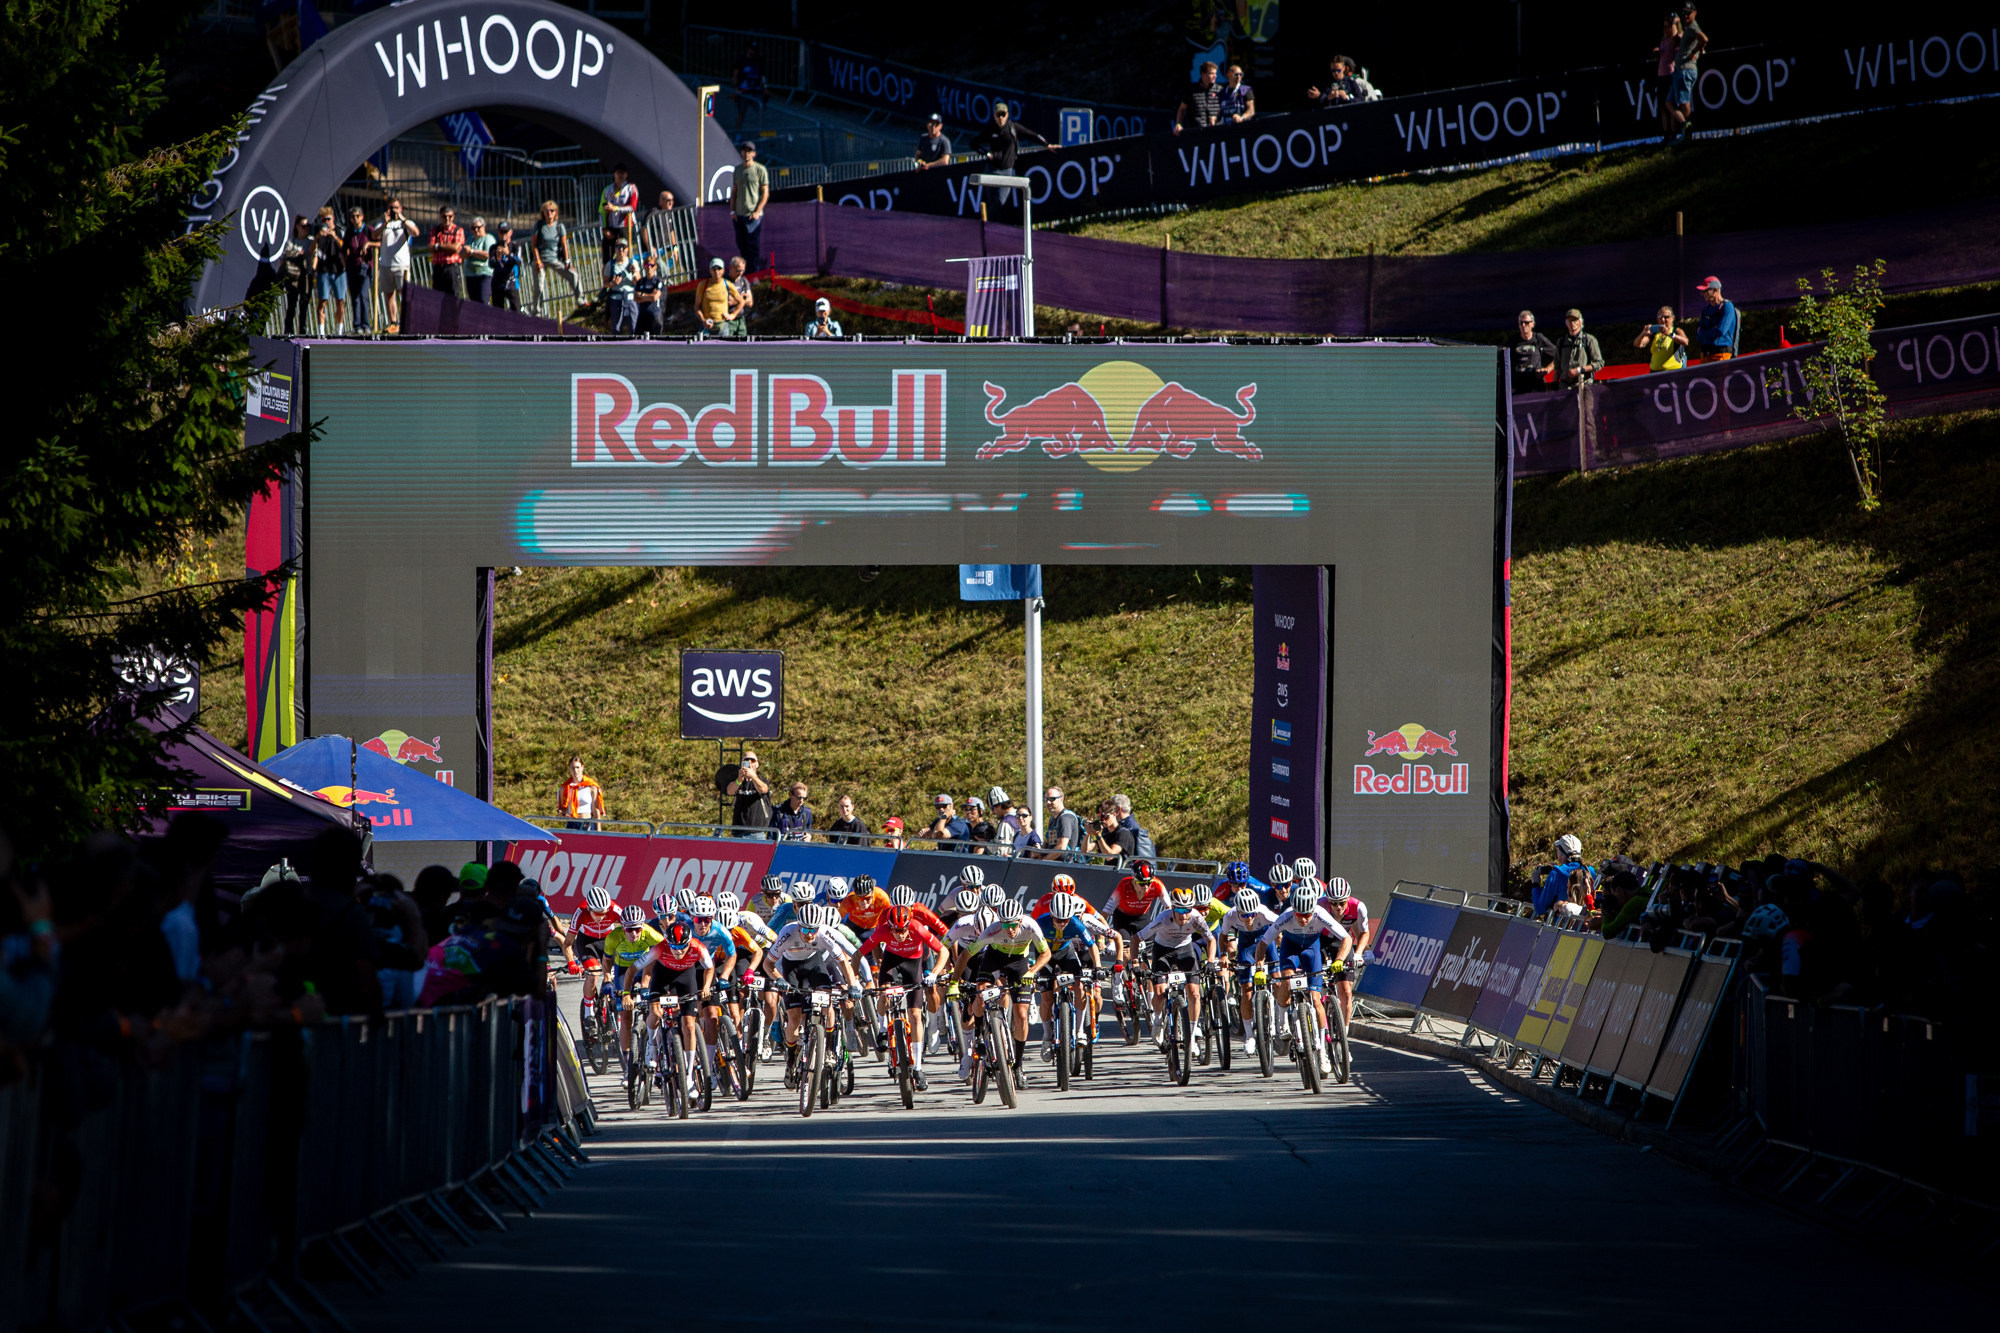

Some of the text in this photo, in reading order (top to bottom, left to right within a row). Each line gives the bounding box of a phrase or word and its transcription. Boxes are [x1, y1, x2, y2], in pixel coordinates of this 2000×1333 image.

[374, 14, 604, 97] WHOOP
[1844, 27, 2000, 91] WHOO
[828, 56, 914, 105] WHOOP
[1624, 58, 1790, 121] WOOP
[1067, 115, 1081, 142] P
[1394, 91, 1561, 152] WHOOP
[1178, 123, 1343, 187] WHOOP
[946, 156, 1116, 216] WOOP
[571, 369, 947, 468] Red Bull
[1274, 613, 1295, 630] WHOOP
[691, 668, 773, 698] aws
[1277, 682, 1288, 697] aws
[1353, 763, 1469, 795] Red Bull
[360, 808, 413, 827] ull
[1271, 819, 1288, 839] MOTUL
[518, 849, 628, 900] MOTUL
[642, 857, 754, 907] MOTUL
[1375, 929, 1444, 977] SHIMANO
